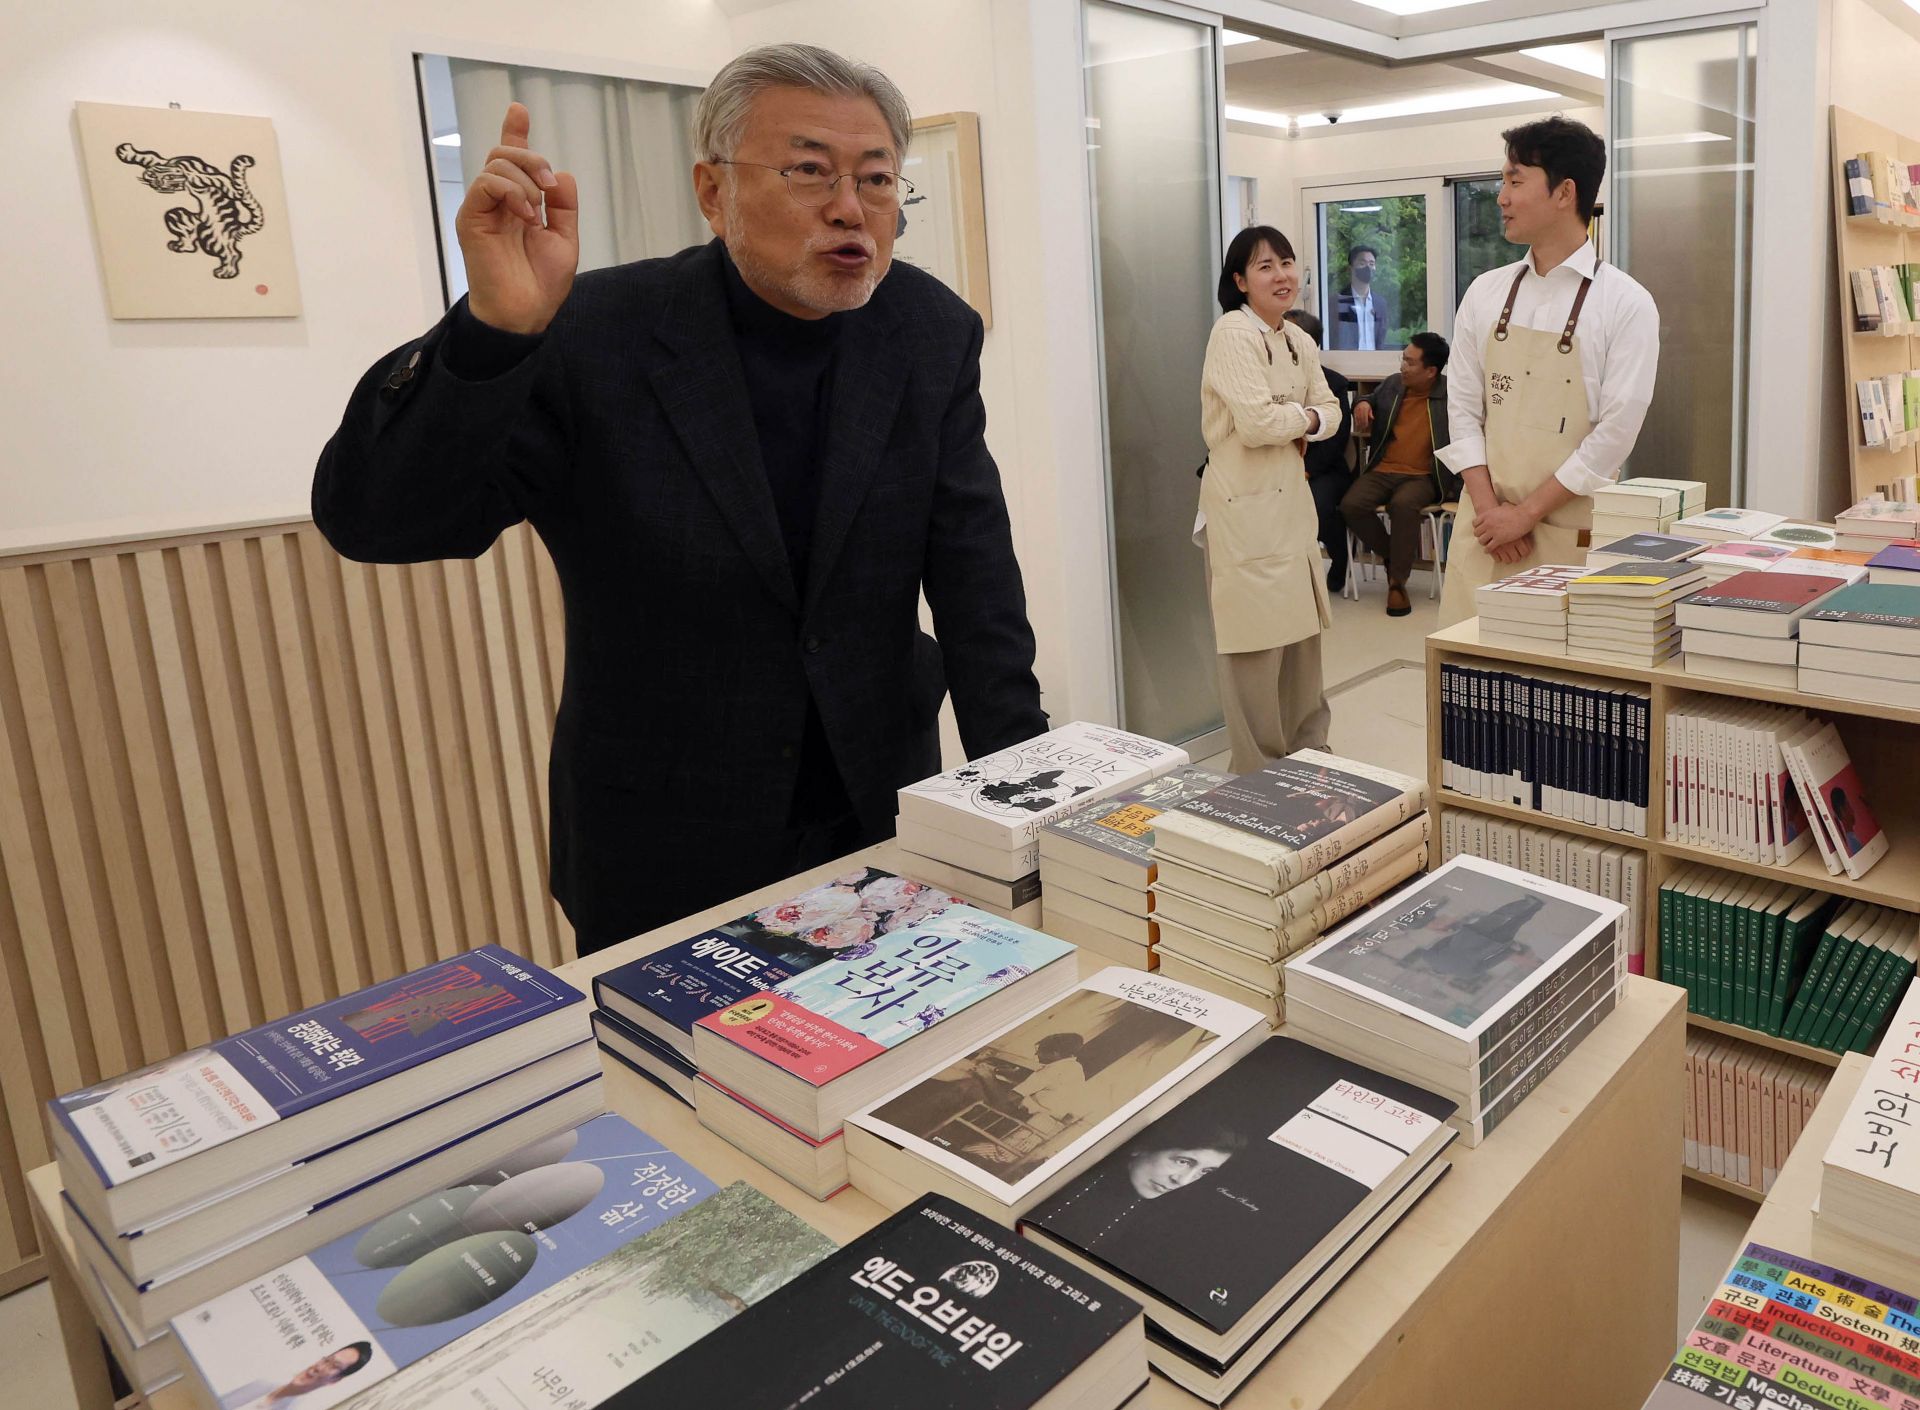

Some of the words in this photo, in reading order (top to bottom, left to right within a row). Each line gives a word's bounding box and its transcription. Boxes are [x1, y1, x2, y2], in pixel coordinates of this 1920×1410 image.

[690, 937, 769, 980] 헤이트
[746, 974, 770, 991] Hate
[895, 935, 971, 988] 인류
[834, 960, 920, 1020] 본사
[1119, 983, 1145, 999] 나는
[1141, 992, 1166, 1004] 왜
[1162, 997, 1208, 1018] 쓰는가
[287, 1019, 342, 1056] 공정하다는
[327, 1048, 365, 1071] 착각
[1335, 1083, 1386, 1110] 타인의
[1384, 1106, 1424, 1126] 고통
[1855, 1089, 1920, 1169] 노비와
[631, 1162, 697, 1210] 적정한
[600, 1200, 644, 1227] 삶
[919, 1206, 951, 1227] 브라이언
[947, 1221, 975, 1240] 그린이
[970, 1234, 996, 1251] 말하는
[995, 1246, 1022, 1265] 세상의
[1018, 1259, 1046, 1279] 시작과
[1060, 1284, 1090, 1306] 그리고
[1750, 1247, 1822, 1278] Practice
[850, 1256, 916, 1300] 엔드
[895, 1285, 968, 1335] 오브
[950, 1315, 1024, 1372] 타임
[1723, 1289, 1760, 1310] 규모
[1767, 1304, 1855, 1347] Induction
[1775, 1288, 1814, 1311] 관찰
[1819, 1305, 1890, 1342] System
[1788, 1276, 1827, 1298] Arts
[1863, 1301, 1883, 1319] 술
[1693, 1336, 1731, 1358] 文章
[1737, 1351, 1778, 1376] 문장
[1713, 1305, 1770, 1332] 귀납법
[1776, 1326, 1843, 1362] Liberal
[1845, 1355, 1878, 1377] Art
[532, 1366, 574, 1405] 나무의
[1671, 1367, 1711, 1393] 技術
[1714, 1384, 1755, 1410] 기술
[1684, 1351, 1742, 1383] 연역법
[1746, 1376, 1820, 1410] Mecha
[1747, 1335, 1841, 1382] Literature
[1849, 1375, 1891, 1403] 文學
